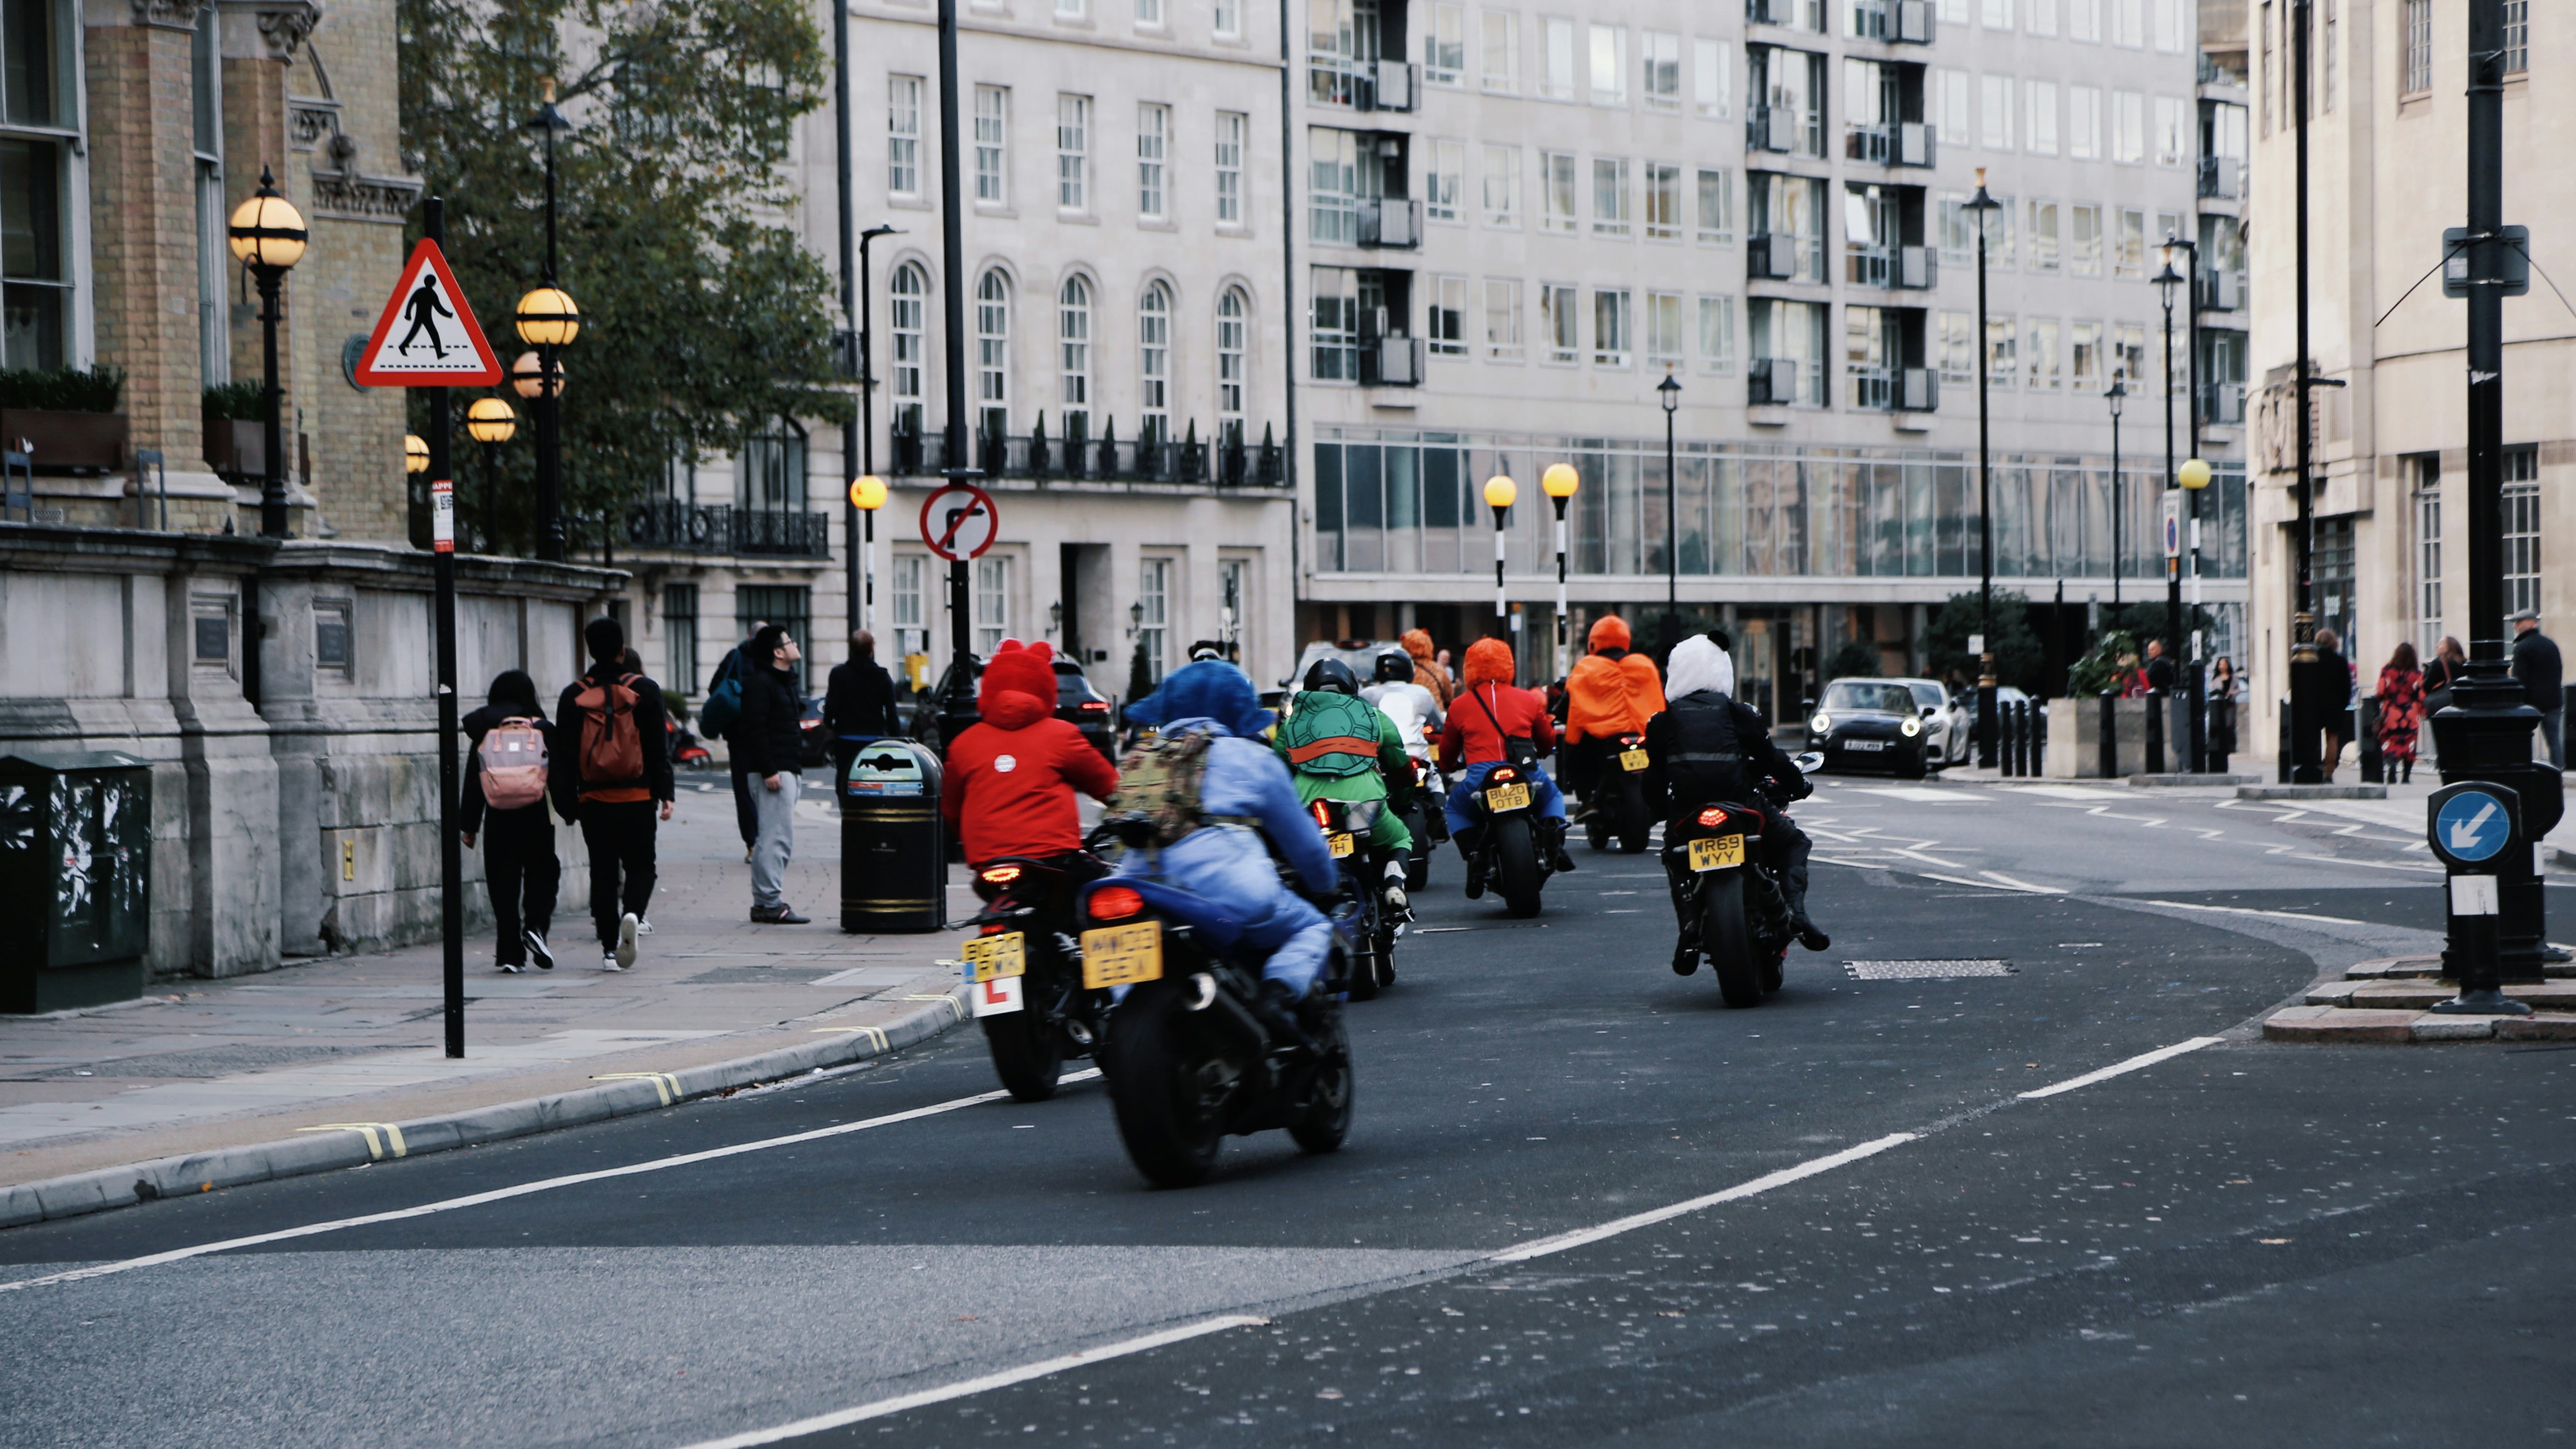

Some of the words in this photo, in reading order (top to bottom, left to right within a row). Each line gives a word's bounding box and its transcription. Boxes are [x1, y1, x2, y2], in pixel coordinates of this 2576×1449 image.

[1490, 785, 1525, 800] BU20
[1496, 796, 1523, 809] OTB
[1693, 836, 1740, 854] WR69
[1700, 850, 1734, 866] WYY
[967, 936, 1021, 960] BG20
[986, 980, 1008, 1004] L
